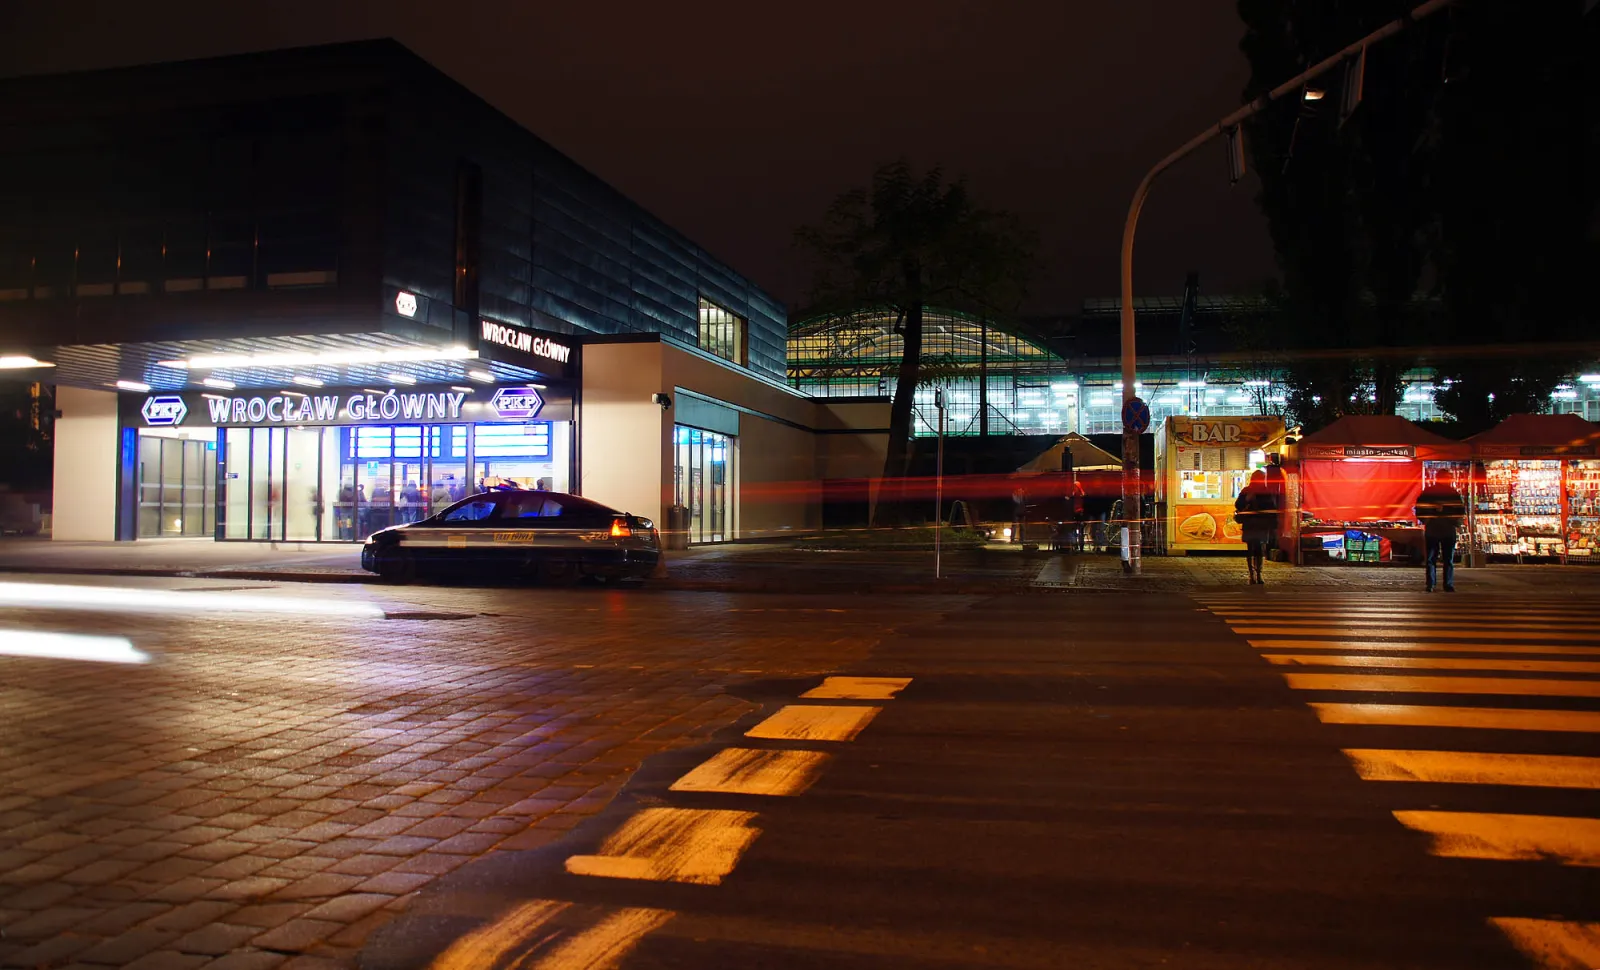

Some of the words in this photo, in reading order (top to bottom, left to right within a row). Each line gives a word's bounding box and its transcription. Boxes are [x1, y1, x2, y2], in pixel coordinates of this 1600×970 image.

[482, 321, 532, 353] WROCŁAW
[533, 337, 570, 364] GŁÓWNY
[208, 396, 339, 423] WROCŁAW
[346, 389, 465, 420] GŁÓWNY
[499, 395, 535, 410] PKP
[150, 404, 181, 418] PKP
[1192, 424, 1242, 442] BAR
[1346, 448, 1374, 456] miasto
[589, 531, 609, 540] 228
